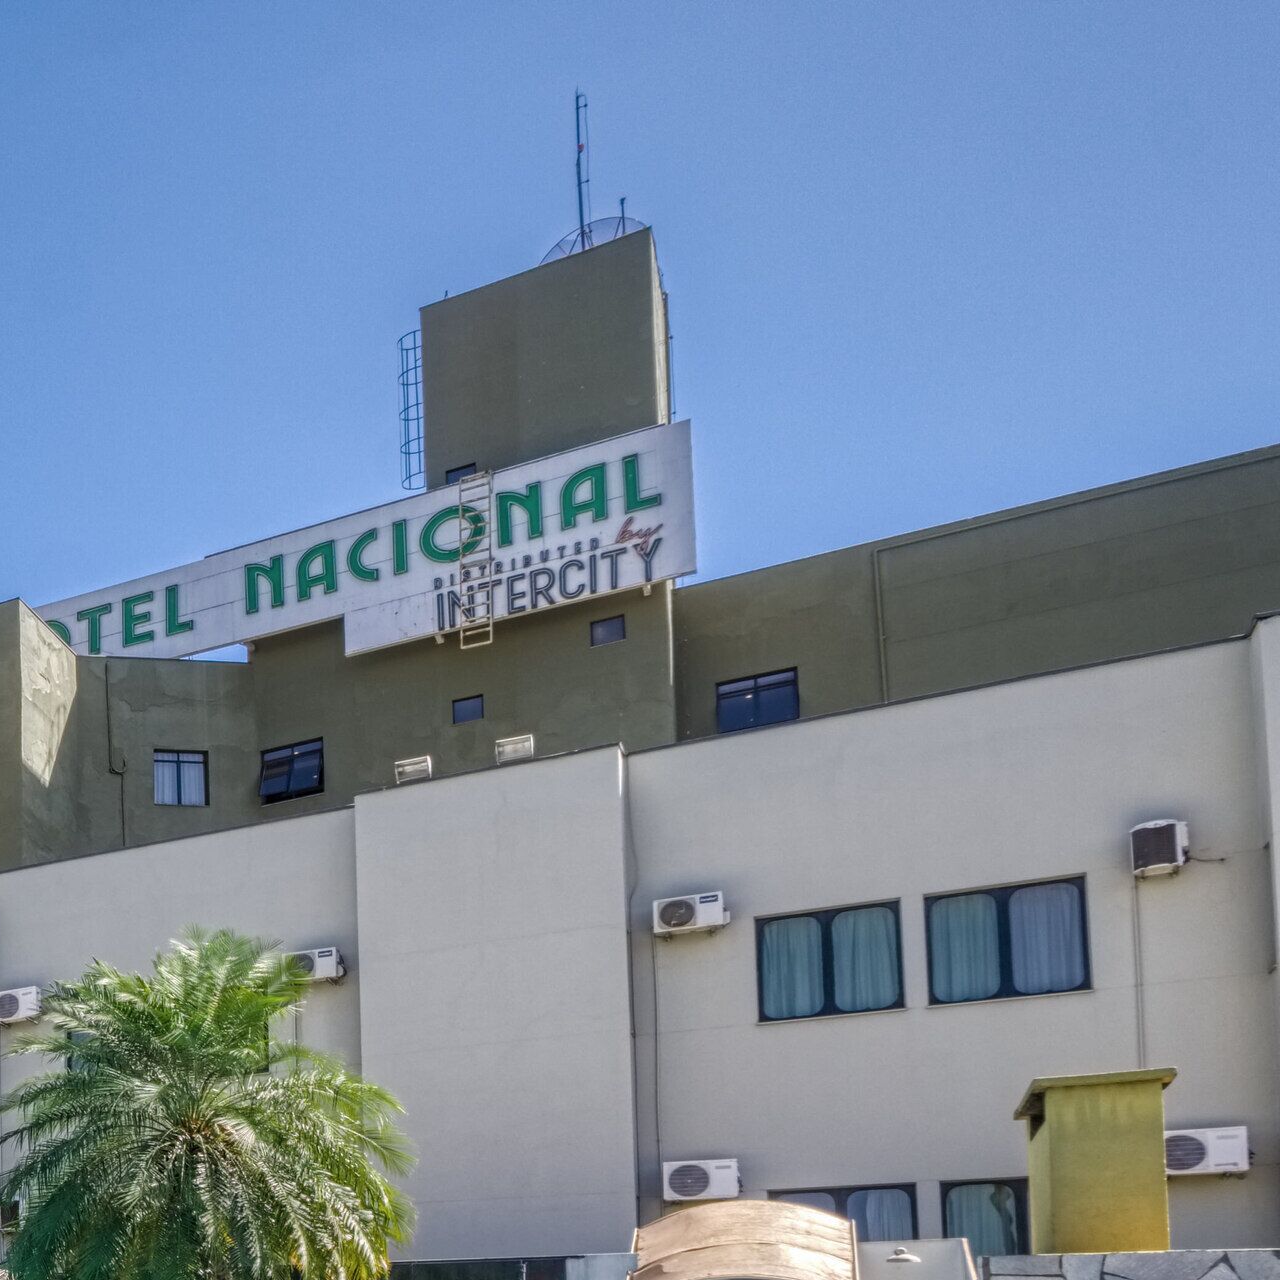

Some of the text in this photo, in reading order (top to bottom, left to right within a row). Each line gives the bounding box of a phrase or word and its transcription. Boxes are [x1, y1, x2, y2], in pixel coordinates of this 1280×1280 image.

[244, 453, 663, 615] NACIONAL
[433, 515, 664, 591] DISTRIBUTED by
[436, 537, 663, 632] INTERCITY
